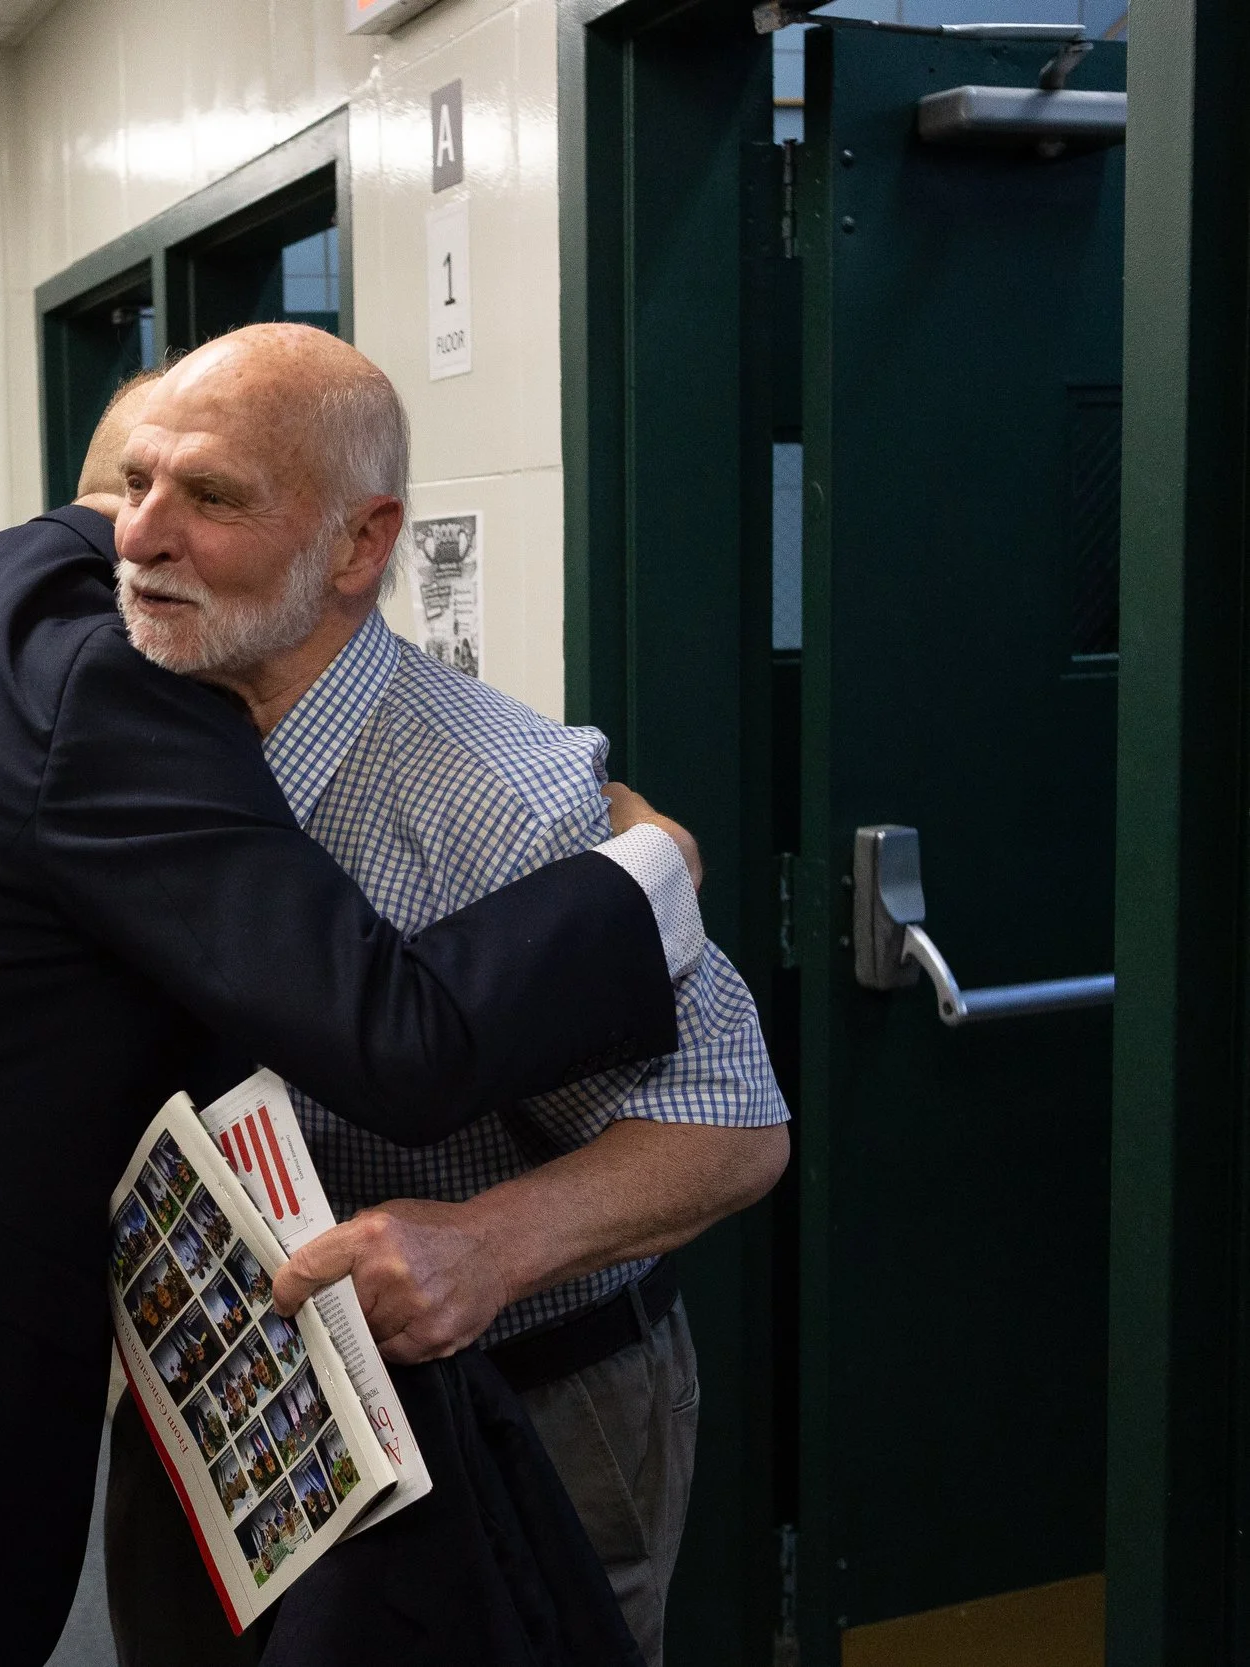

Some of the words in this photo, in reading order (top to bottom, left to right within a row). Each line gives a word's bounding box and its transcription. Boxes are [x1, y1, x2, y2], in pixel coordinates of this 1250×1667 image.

[436, 103, 455, 168] A
[443, 251, 457, 306] 1
[436, 329, 465, 354] FLOOR
[130, 1341, 168, 1416] Generation
[167, 1416, 189, 1454] From
